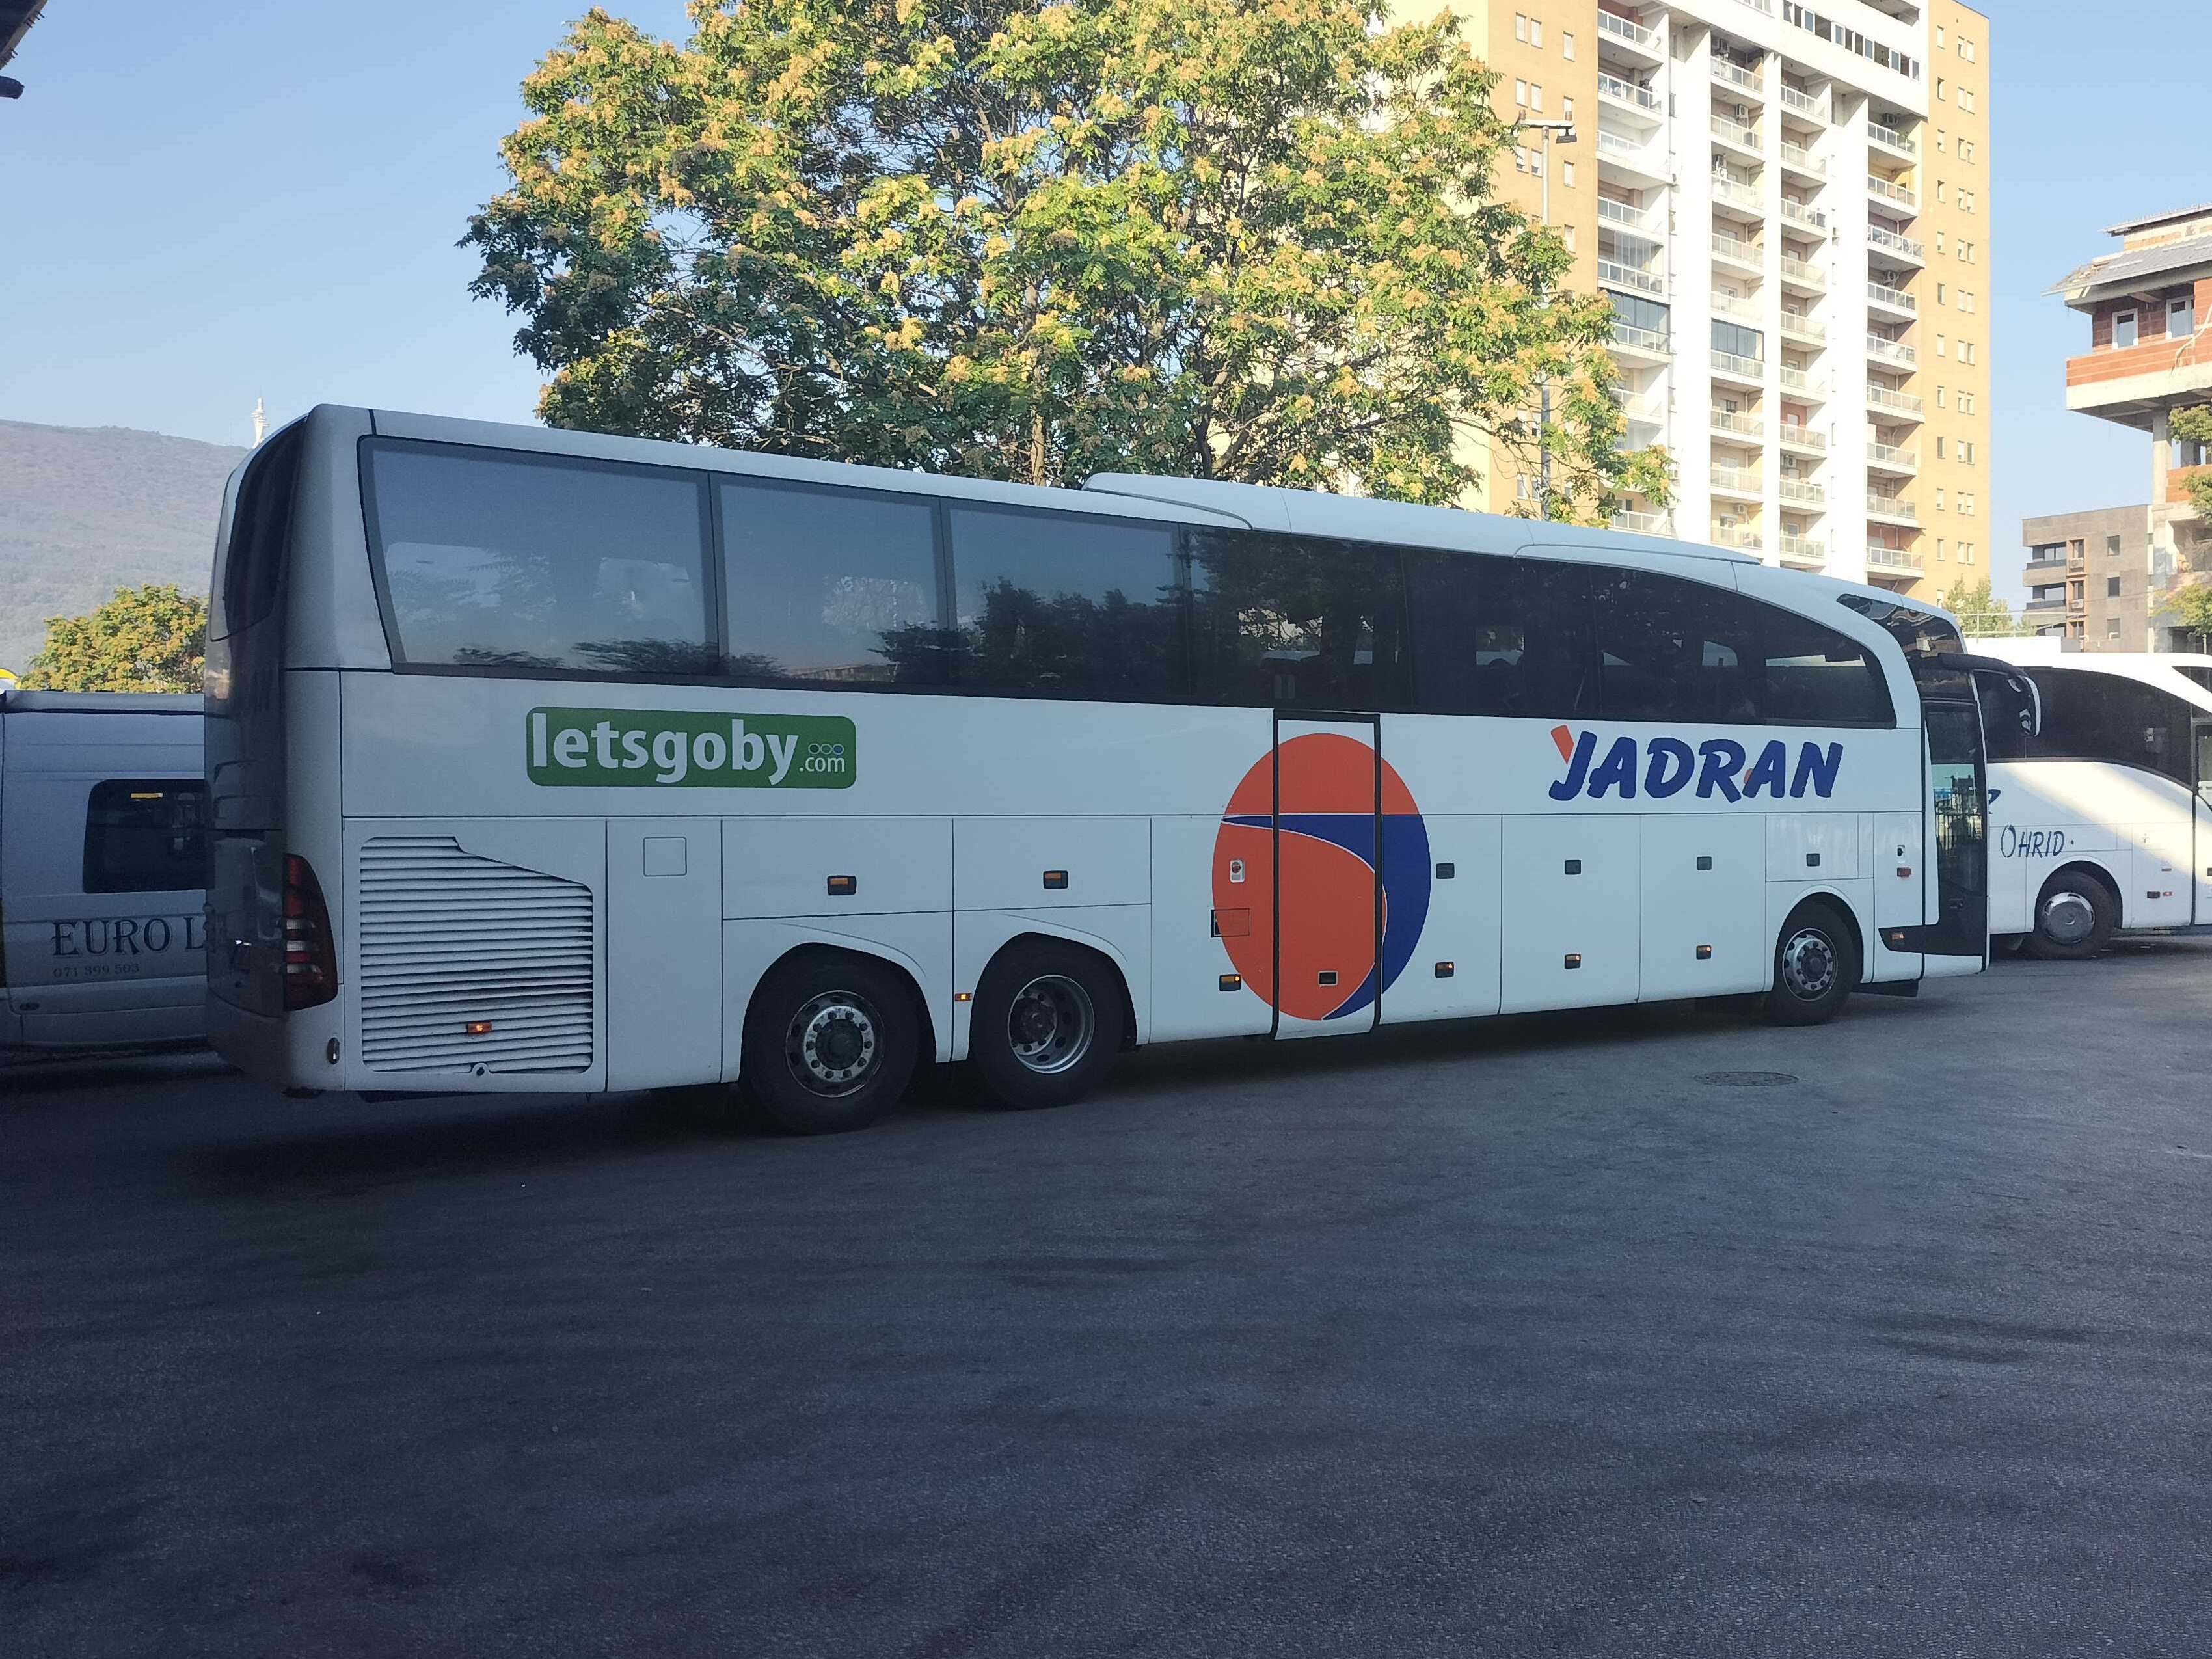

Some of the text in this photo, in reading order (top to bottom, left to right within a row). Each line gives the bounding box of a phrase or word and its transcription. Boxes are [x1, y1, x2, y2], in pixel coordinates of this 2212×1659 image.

[1549, 725, 1844, 803] JADRAN
[2001, 824, 2065, 859] OHRID
[51, 918, 172, 958] EURO
[53, 967, 78, 978] 071
